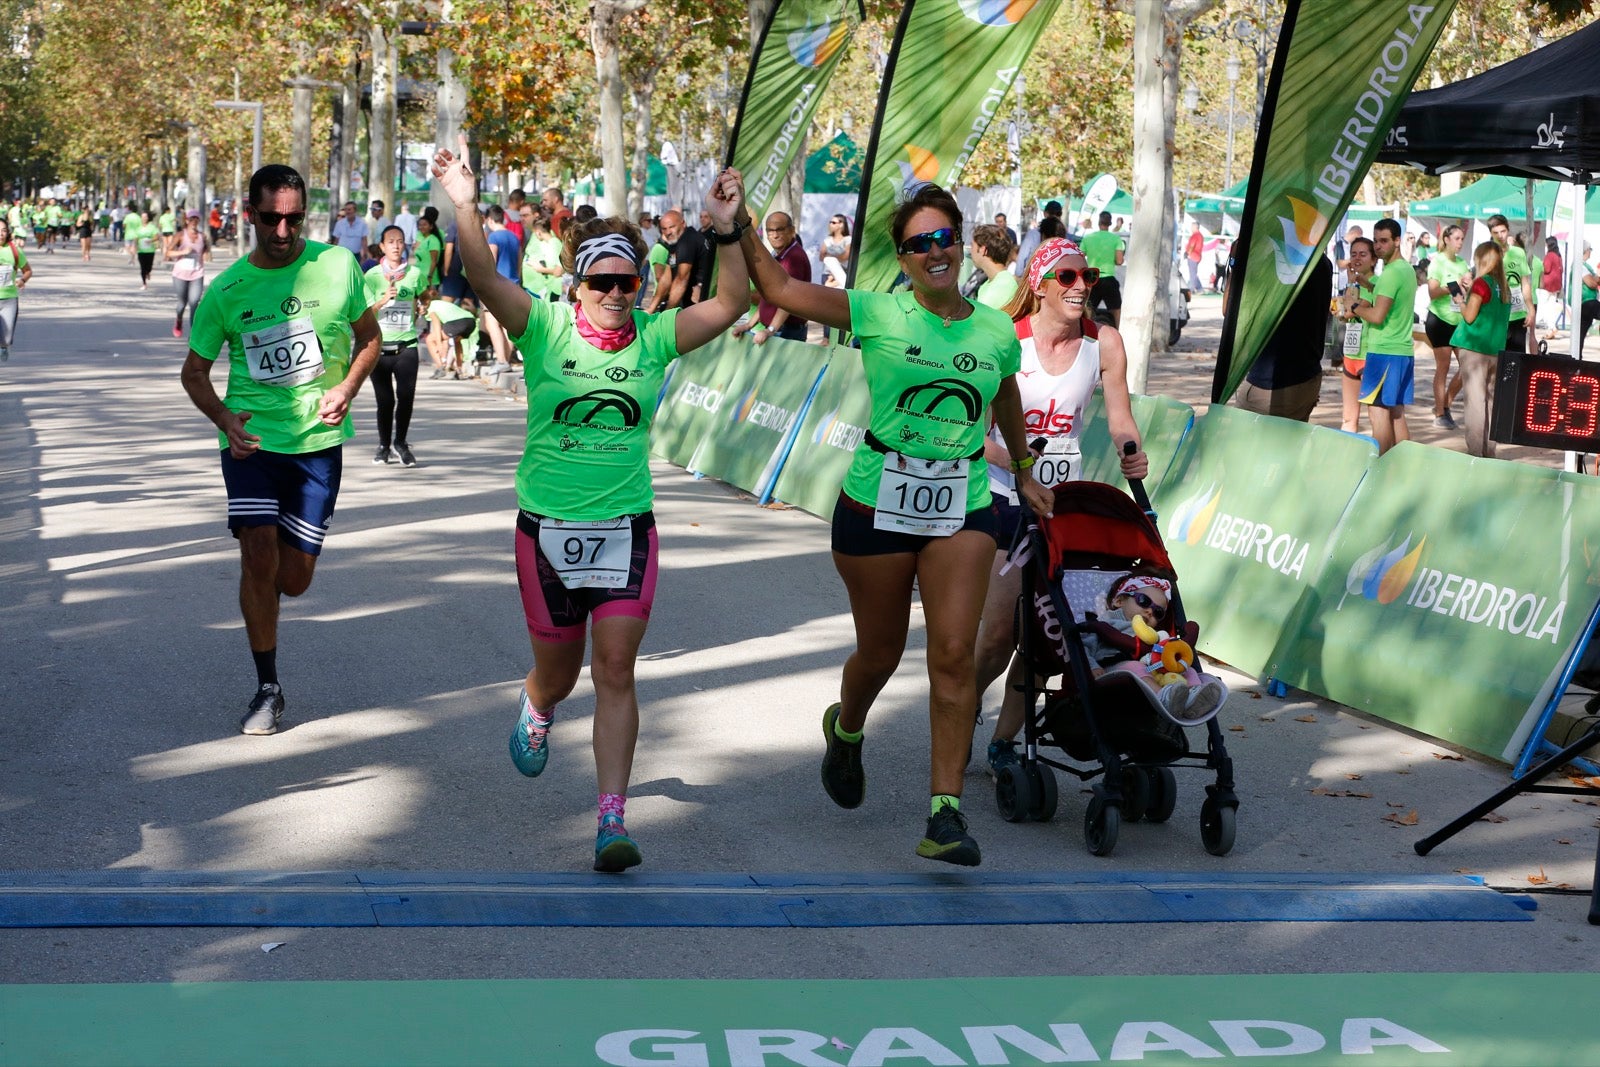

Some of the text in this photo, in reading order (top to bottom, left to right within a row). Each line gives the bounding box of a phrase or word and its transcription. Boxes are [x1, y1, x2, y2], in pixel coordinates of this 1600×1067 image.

[1313, 4, 1434, 206] IBERDROLA
[751, 83, 817, 208] IBERDROLA
[384, 311, 406, 322] 167
[259, 341, 310, 374] 492
[906, 356, 945, 369] IBERDROLA
[562, 370, 599, 380] IBERDROLA
[904, 409, 924, 419] FORMA
[1024, 398, 1074, 436] als
[827, 420, 866, 452] IBERD
[895, 482, 953, 514] 100
[563, 537, 607, 565] 97
[1406, 567, 1567, 644] IBERDROLA
[595, 1017, 1451, 1067] GRANADA
